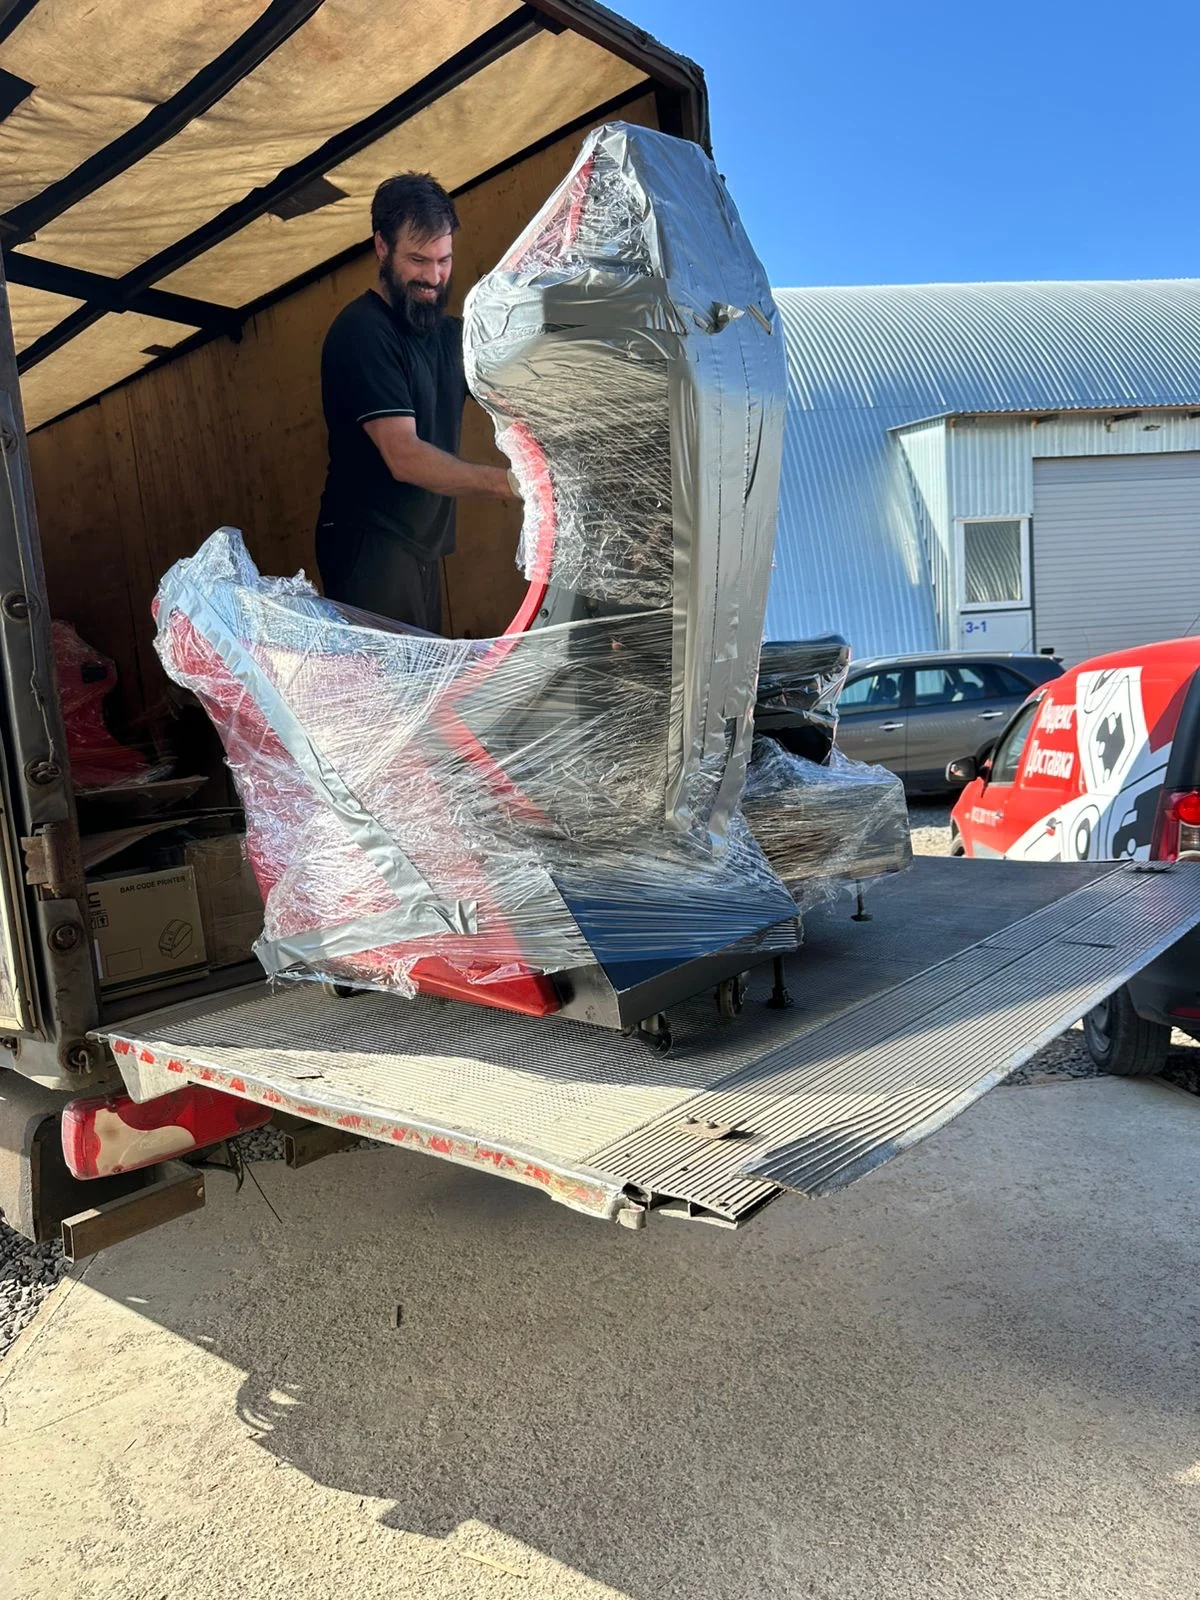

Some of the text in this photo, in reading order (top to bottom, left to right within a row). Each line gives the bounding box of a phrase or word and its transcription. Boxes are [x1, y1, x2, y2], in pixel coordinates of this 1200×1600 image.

[965, 620, 987, 633] 3-1
[1024, 740, 1075, 779] Доставка
[120, 875, 186, 894] BAR CODE PRINTER
